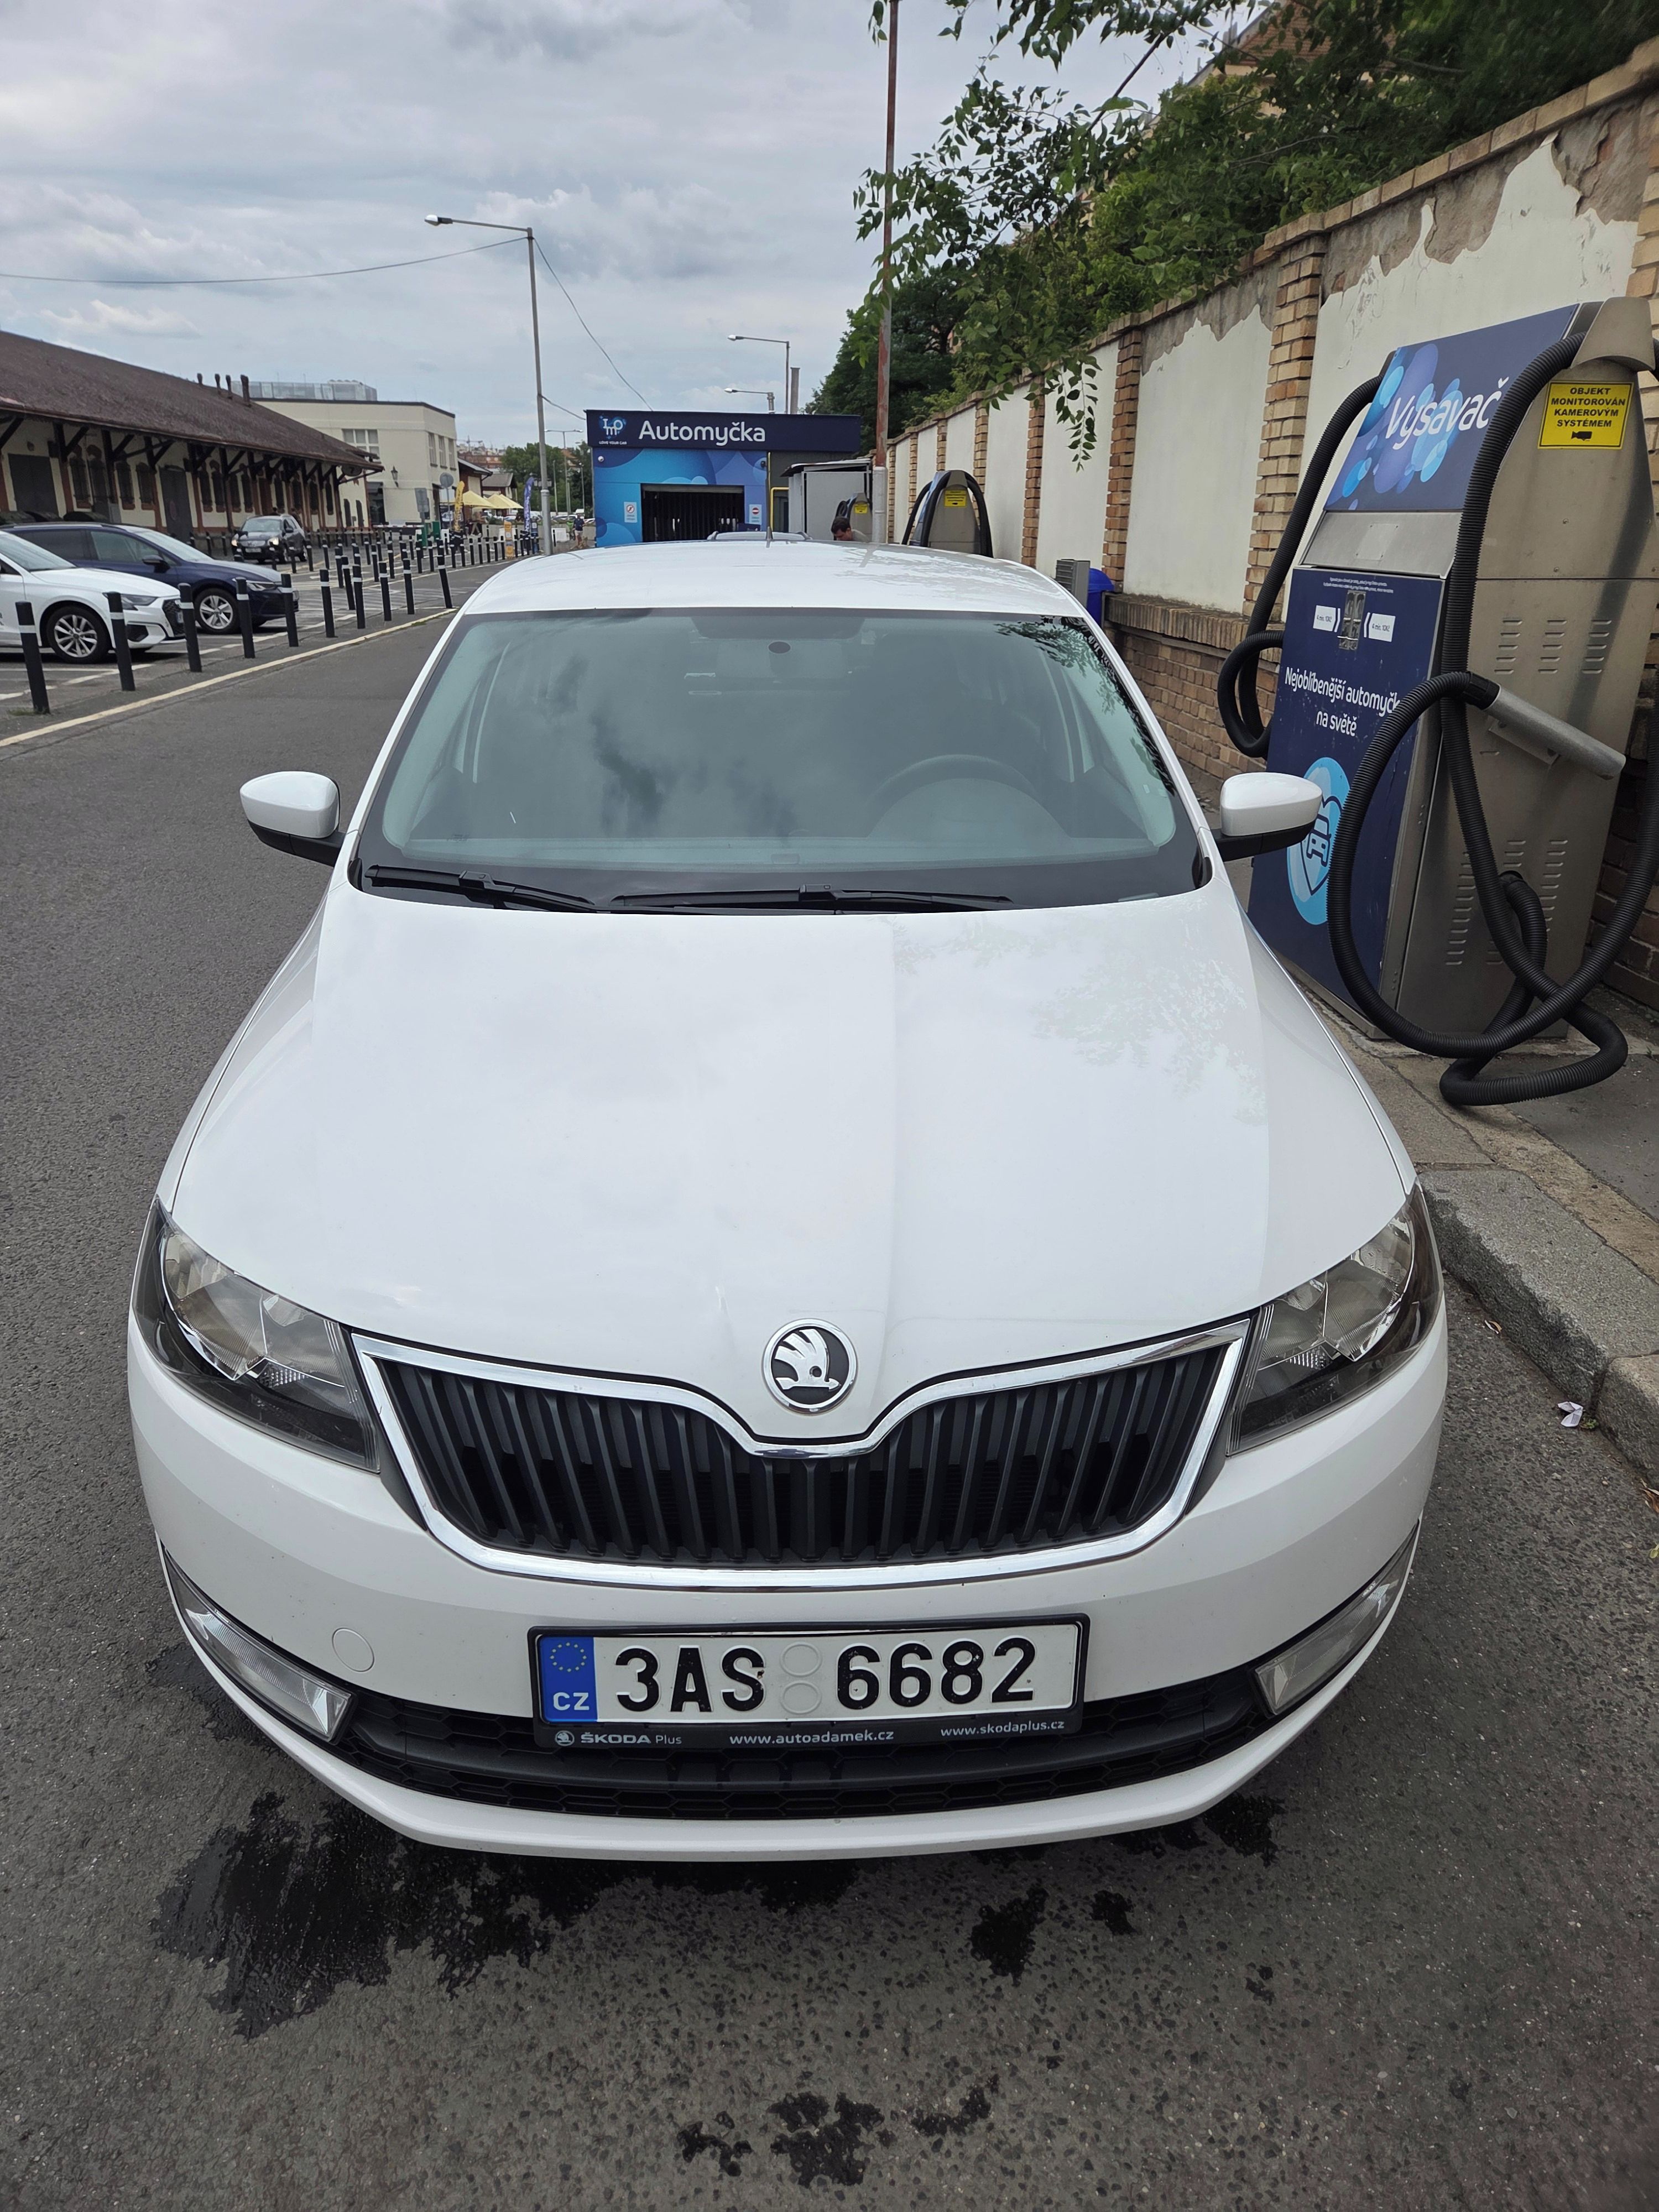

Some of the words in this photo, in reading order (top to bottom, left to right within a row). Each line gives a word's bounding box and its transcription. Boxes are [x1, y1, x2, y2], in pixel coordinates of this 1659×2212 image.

[1551, 397, 1626, 406] MONITOROVÁN
[1385, 377, 1509, 450] Vysavač
[1554, 408, 1619, 416] KAMEROVÝM
[1557, 418, 1612, 427] SYSTÉMEM
[639, 420, 765, 446] Automyčka
[1285, 666, 1347, 703] Nejoblíbenější
[1345, 686, 1401, 717] automyčk
[1316, 711, 1328, 728] na
[1329, 713, 1357, 737] světě
[614, 1646, 765, 1713] 3AS
[837, 1636, 1036, 1710] 6682
[553, 1692, 589, 1710] CZ
[941, 1719, 1065, 1737] www.skodaplus.cz
[580, 1731, 651, 1744] ŠKODA
[655, 1734, 682, 1745] Plus
[729, 1730, 894, 1745] www.autoadamek.cz
